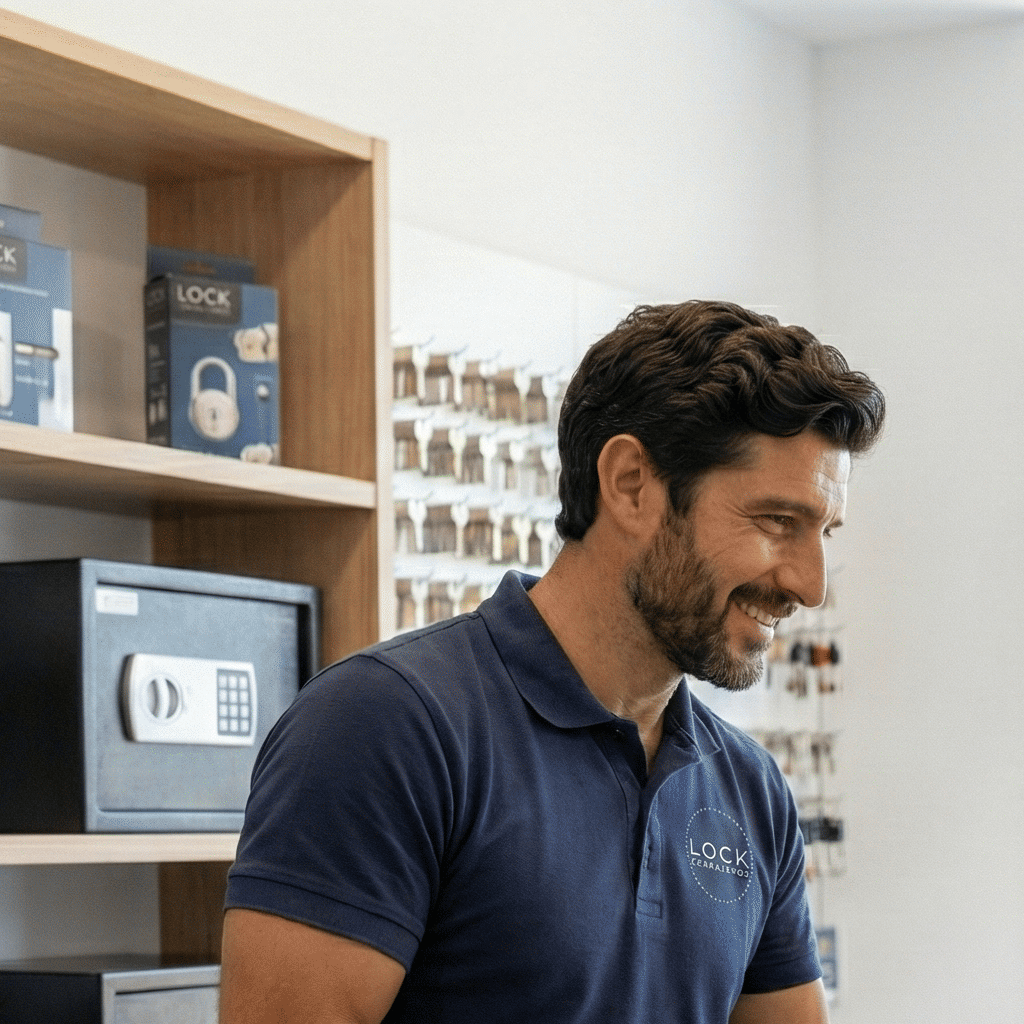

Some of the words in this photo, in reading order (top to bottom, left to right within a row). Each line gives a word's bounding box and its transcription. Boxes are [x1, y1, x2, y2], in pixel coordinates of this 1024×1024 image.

[0, 244, 17, 265] K
[177, 283, 231, 307] LOCK
[689, 838, 750, 870] LOCK
